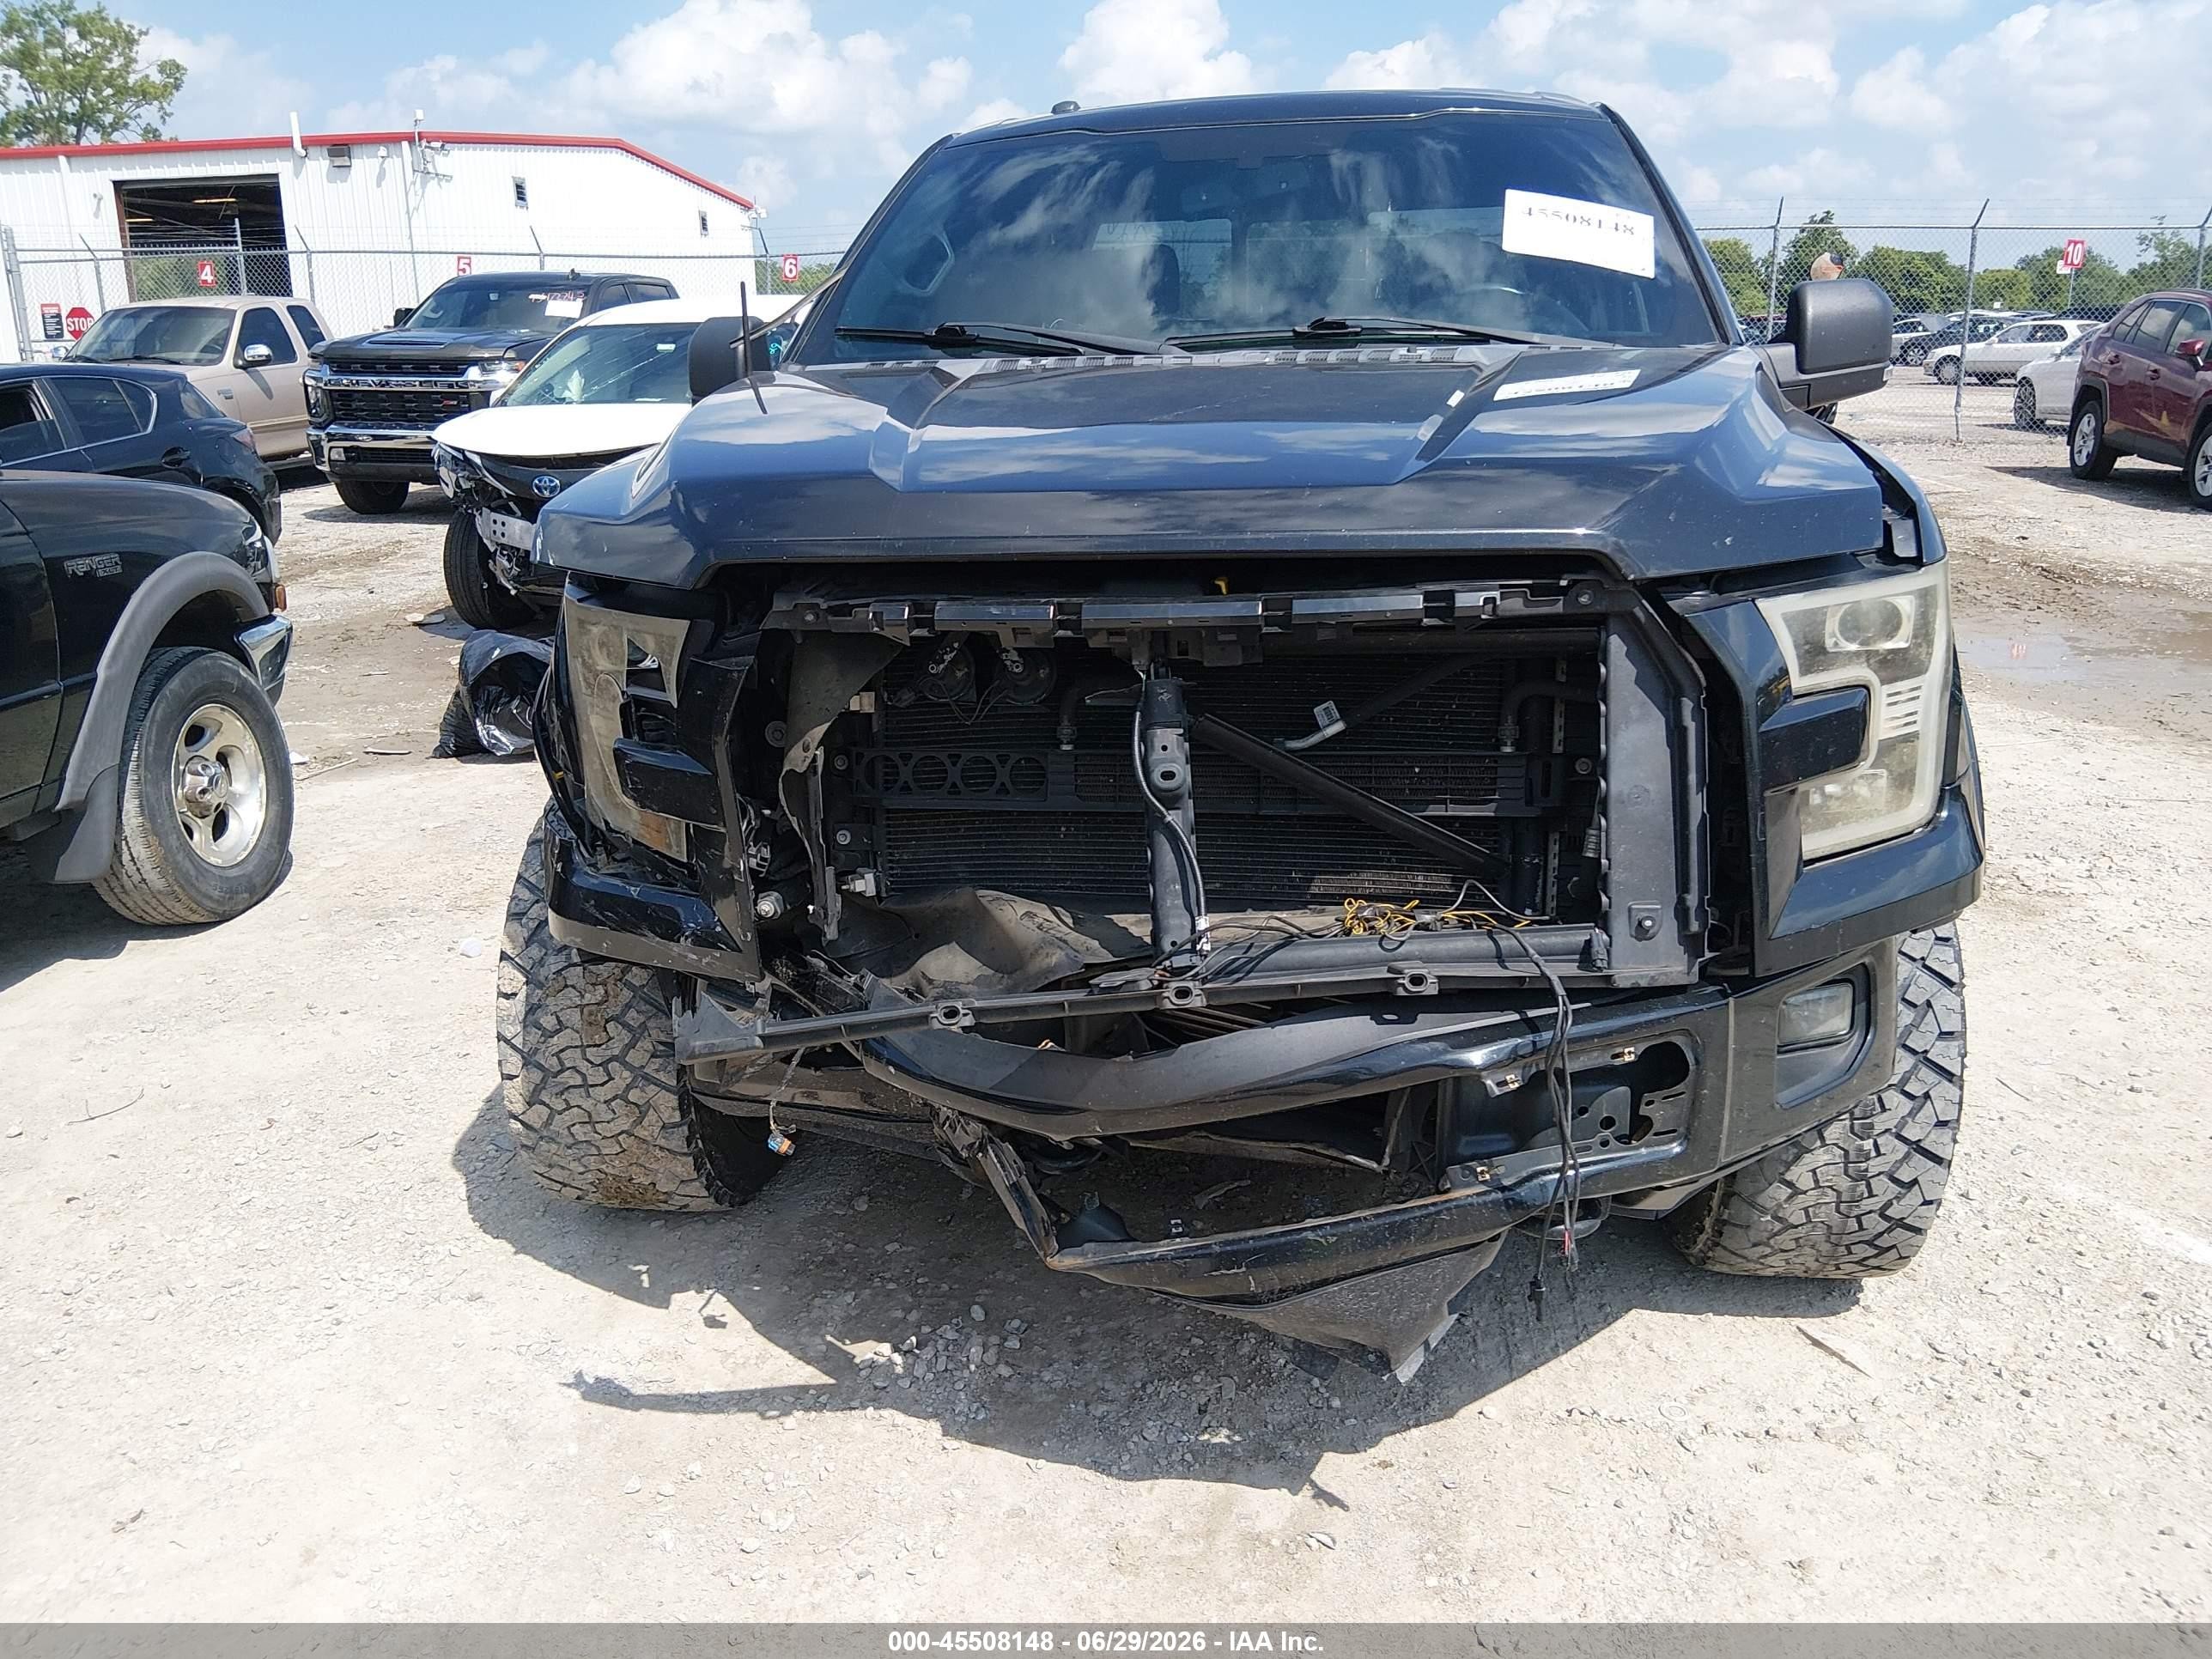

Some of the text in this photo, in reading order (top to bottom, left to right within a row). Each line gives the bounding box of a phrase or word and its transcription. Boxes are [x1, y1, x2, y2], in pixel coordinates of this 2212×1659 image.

[2067, 242, 2082, 265] 10
[201, 264, 214, 284] 4
[459, 258, 471, 276] 5
[784, 258, 797, 278] 6
[64, 552, 122, 578] RANGER
